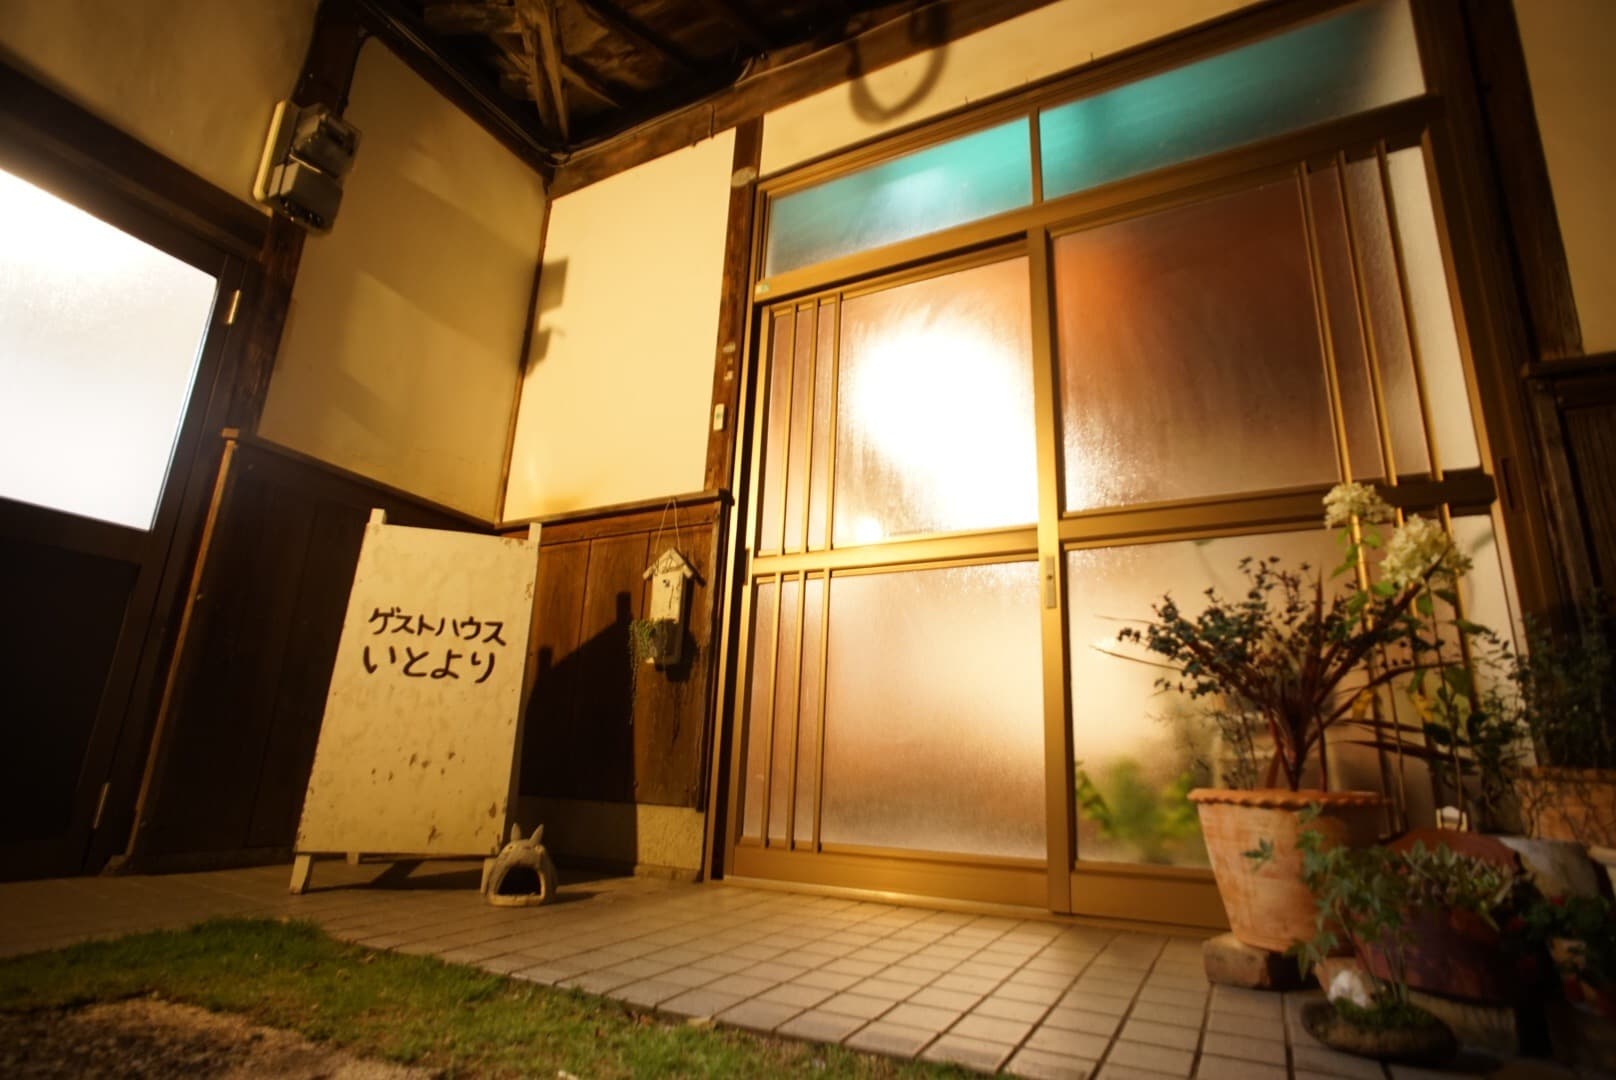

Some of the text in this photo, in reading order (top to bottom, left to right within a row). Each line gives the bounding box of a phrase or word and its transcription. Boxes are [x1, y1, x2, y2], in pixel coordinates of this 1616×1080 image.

[368, 606, 507, 646] ゲストハウス
[363, 645, 495, 684] いとより
